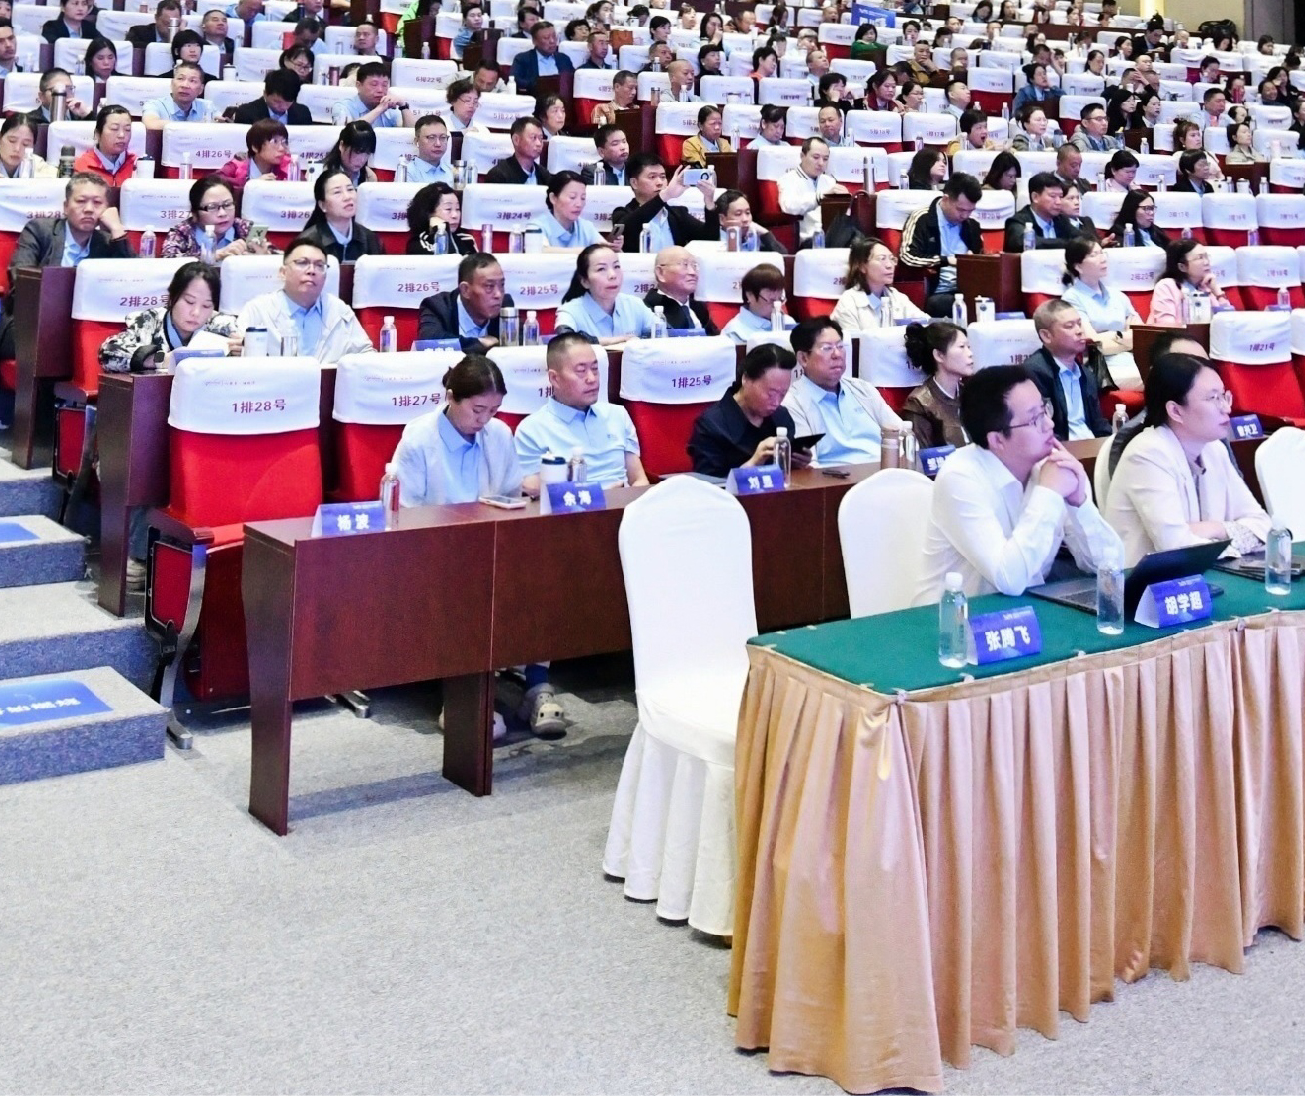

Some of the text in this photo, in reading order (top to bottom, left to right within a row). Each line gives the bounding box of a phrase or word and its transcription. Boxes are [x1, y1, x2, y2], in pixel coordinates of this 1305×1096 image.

[196, 149, 232, 159] 4排26号
[161, 210, 191, 220] 3排27
[281, 211, 310, 219] 3排26
[497, 212, 532, 220] 3排24号
[397, 281, 440, 294] 2排26号
[520, 285, 559, 296] 2排25号
[1249, 342, 1276, 352] 1排21号
[671, 375, 712, 389] 1排25号
[392, 392, 442, 407] 1排27号
[232, 398, 286, 414] 1排28号
[985, 625, 1031, 652] 张腾飞
